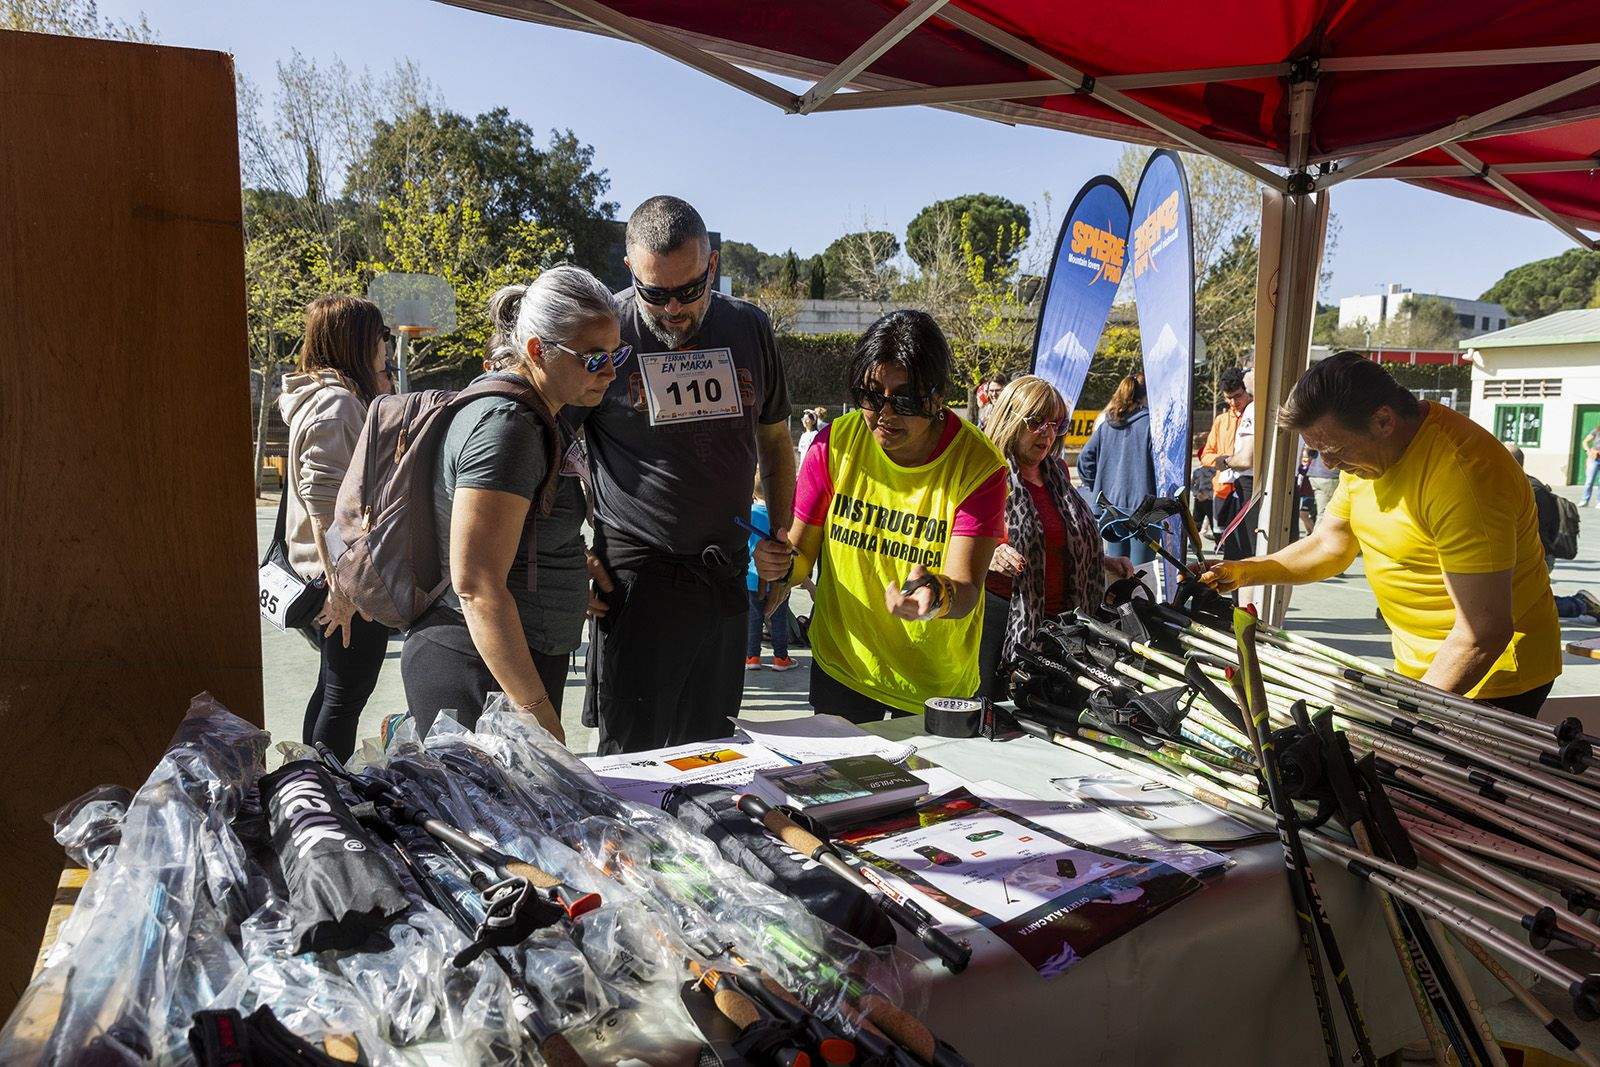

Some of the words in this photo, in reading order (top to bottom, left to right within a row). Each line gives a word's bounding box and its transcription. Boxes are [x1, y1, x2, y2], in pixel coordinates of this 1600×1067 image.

[1071, 221, 1126, 267] SPHERE
[1068, 253, 1088, 268] Mountain
[661, 363, 677, 374] EN
[680, 360, 714, 372] MARXA
[666, 378, 722, 406] 110
[833, 494, 948, 543] INSTRUCTOR
[830, 524, 878, 553] MARXA
[880, 538, 943, 568] NORDICA
[1060, 897, 1091, 914] OFERTA
[1044, 913, 1058, 923] LA
[1018, 919, 1049, 937] CARTA
